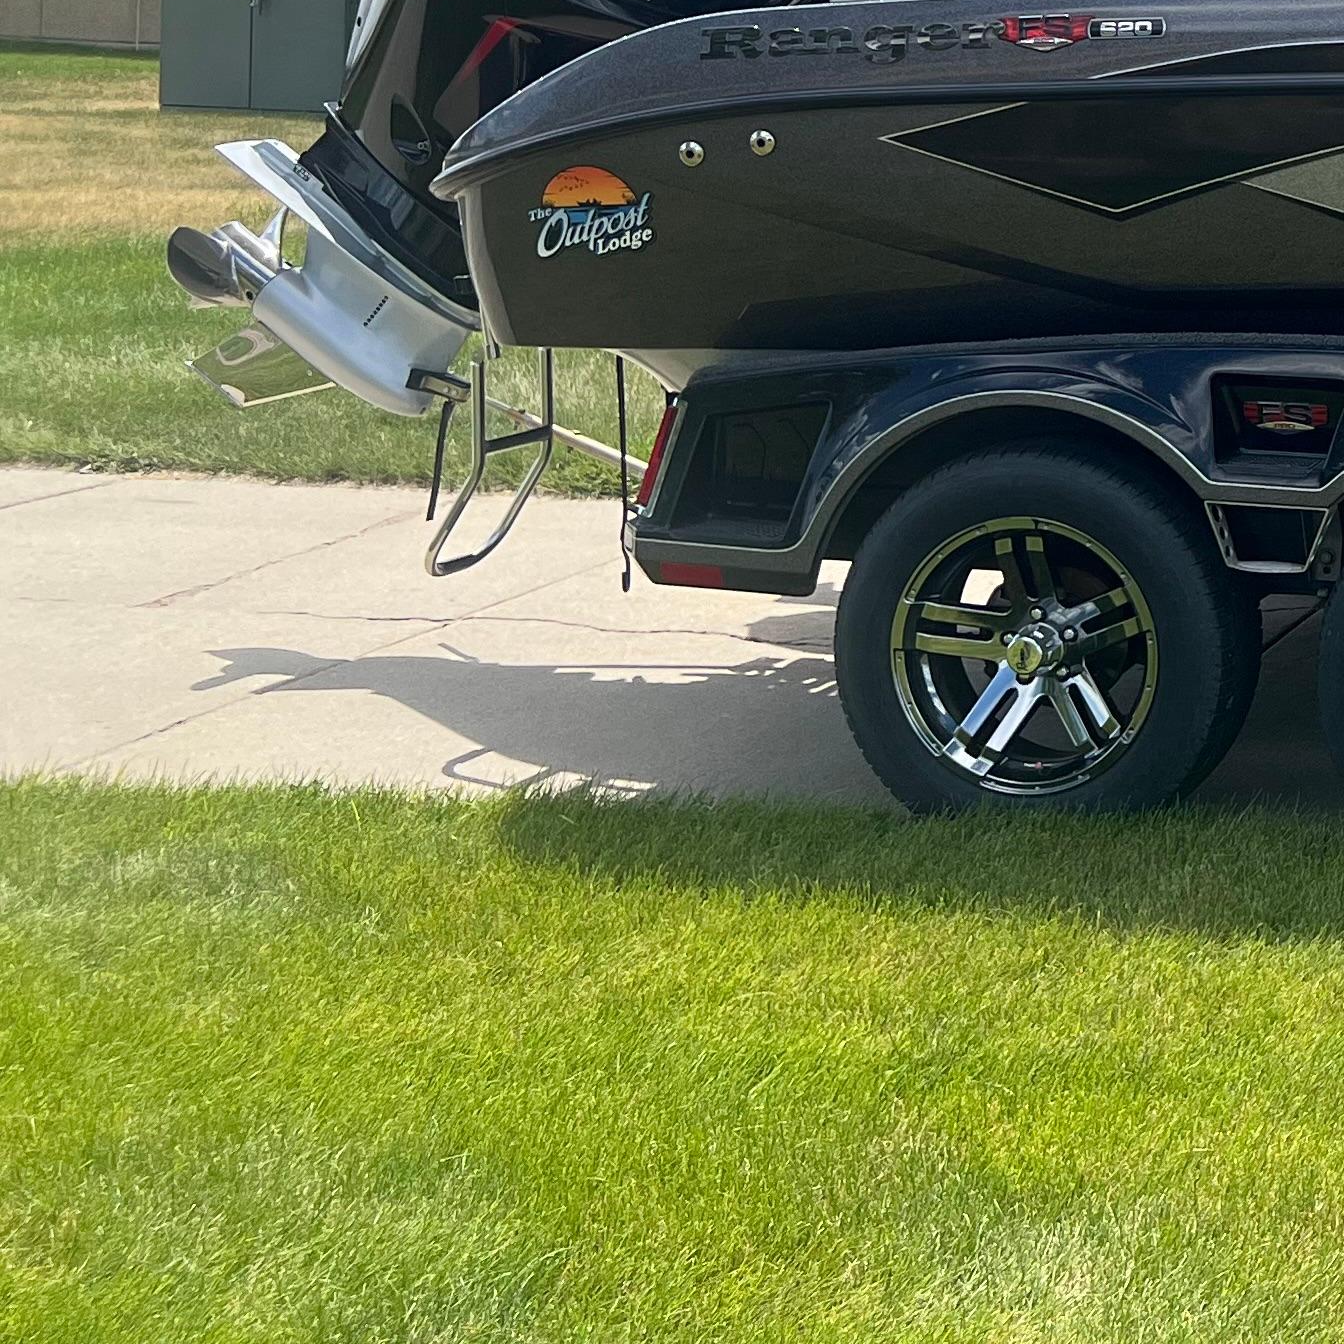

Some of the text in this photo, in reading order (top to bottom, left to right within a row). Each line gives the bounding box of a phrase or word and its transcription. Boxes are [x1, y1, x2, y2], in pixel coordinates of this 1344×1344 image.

[699, 19, 1006, 64] Ranger
[1100, 21, 1153, 37] 620
[528, 207, 552, 222] The
[537, 192, 651, 258] Outpost
[596, 227, 653, 255] Lodge
